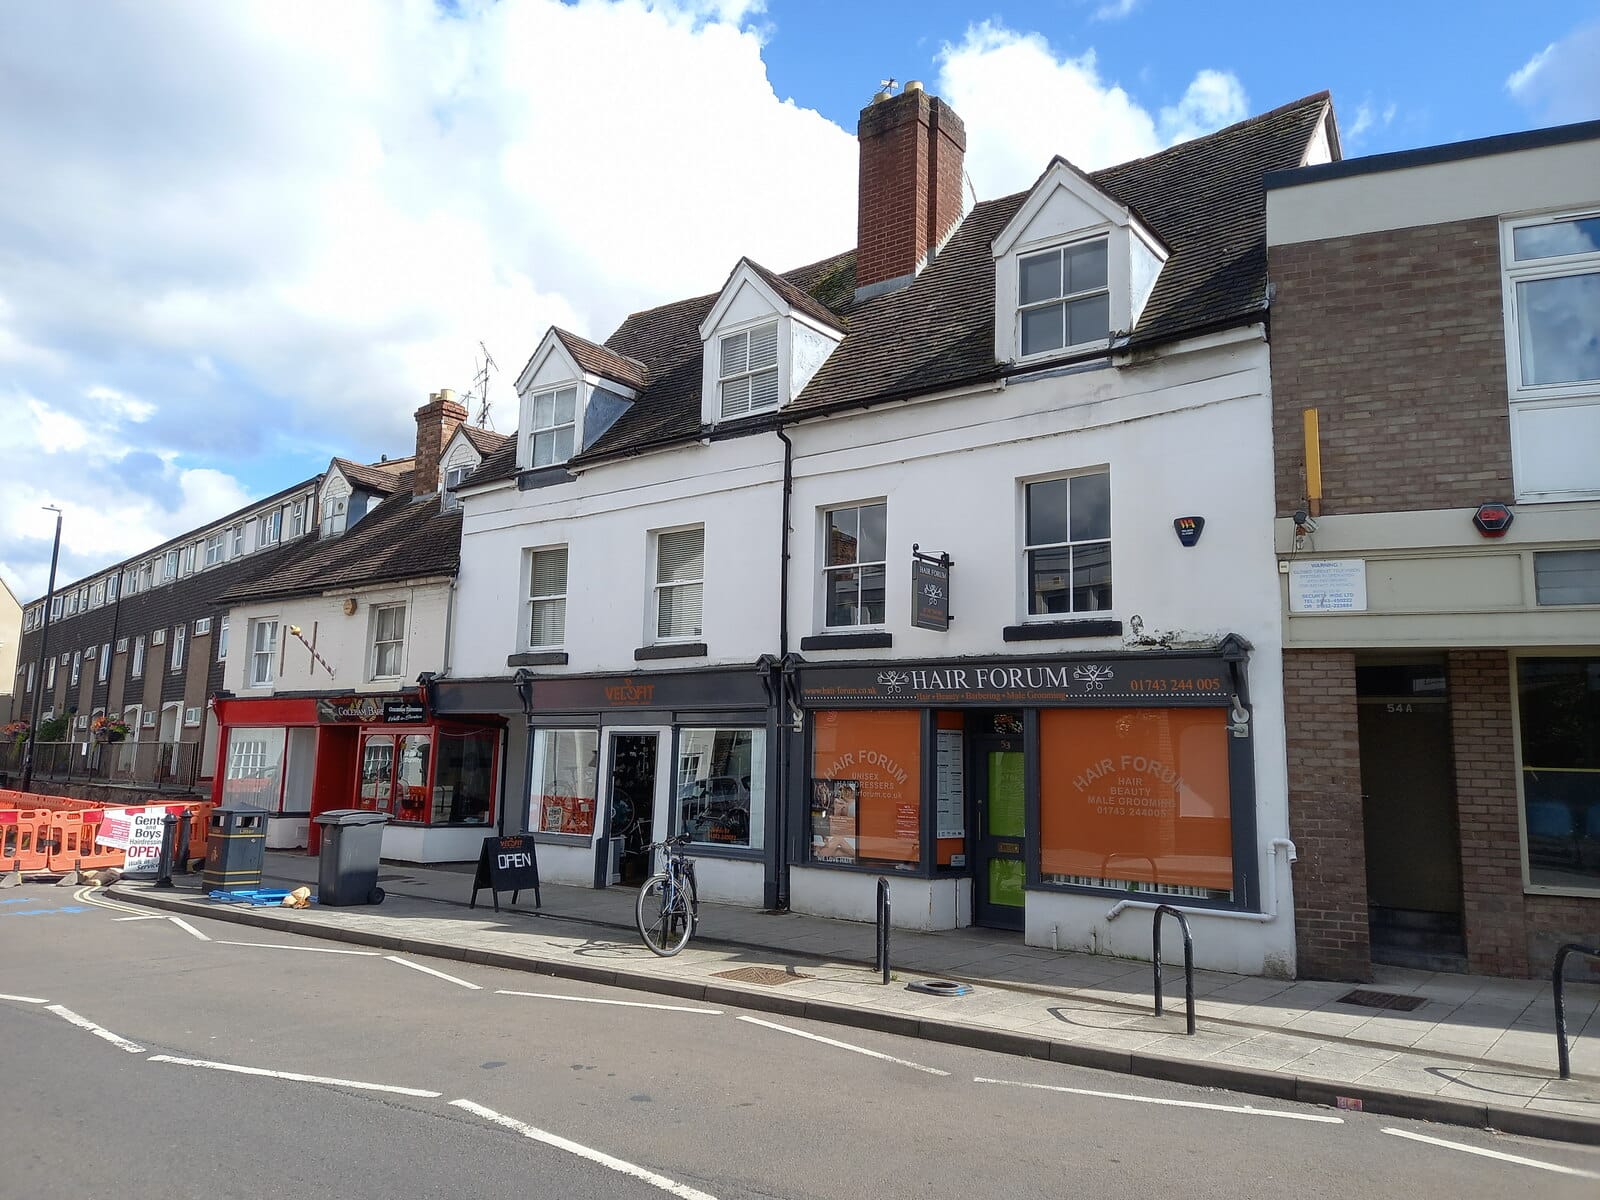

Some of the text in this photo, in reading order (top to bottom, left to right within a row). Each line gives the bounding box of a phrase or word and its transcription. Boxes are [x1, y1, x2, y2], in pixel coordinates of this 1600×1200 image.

[919, 566, 931, 576] HAIR
[911, 667, 1070, 690] HAIR FORUM
[1130, 678, 1220, 691] 01743 244 005
[824, 749, 909, 785] HAIR FORUM
[851, 772, 879, 780] UNISEX
[1072, 755, 1185, 793] HAIR FORUM
[1118, 777, 1143, 786] HAIR
[1110, 787, 1151, 797] BEAUTY
[1087, 796, 1115, 805] MALE
[1097, 806, 1168, 817] 01743 244005
[135, 815, 165, 826] Gents
[135, 828, 161, 840] Boys
[128, 846, 162, 858] OPEN
[497, 852, 532, 870] OPEN
